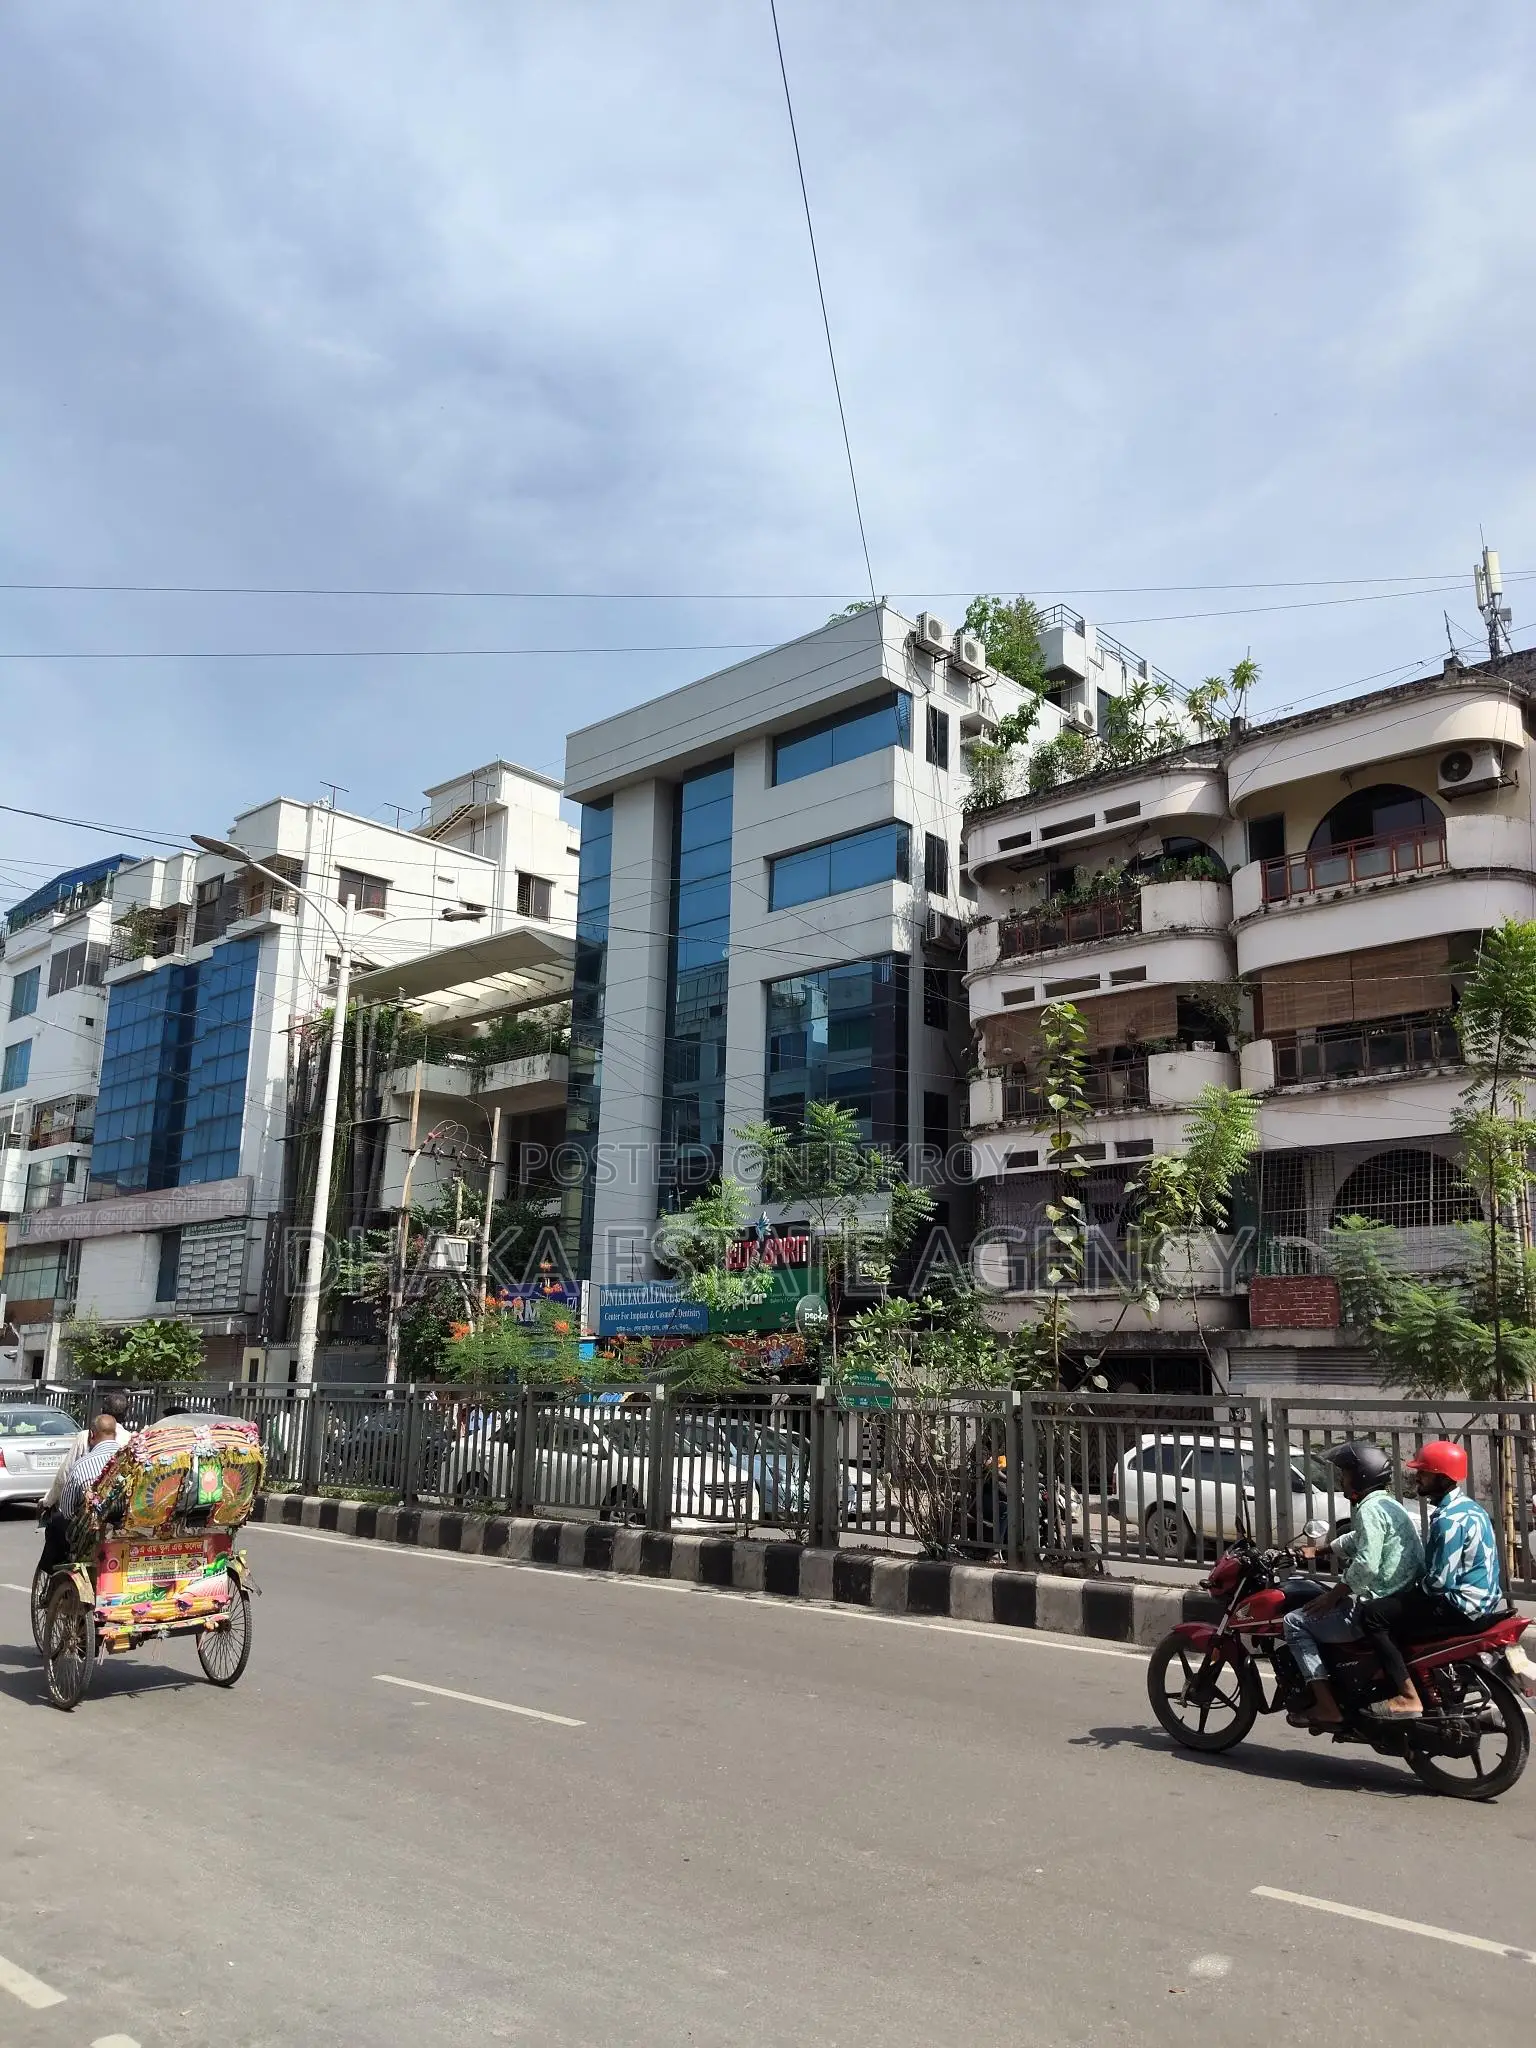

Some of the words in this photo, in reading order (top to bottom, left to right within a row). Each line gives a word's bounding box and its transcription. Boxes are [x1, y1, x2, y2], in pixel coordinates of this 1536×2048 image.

[764, 1236, 809, 1265] SPIRIT
[600, 1288, 628, 1307] DENTAL
[628, 1285, 674, 1305] EXCELLENCE
[649, 1310, 655, 1319] &
